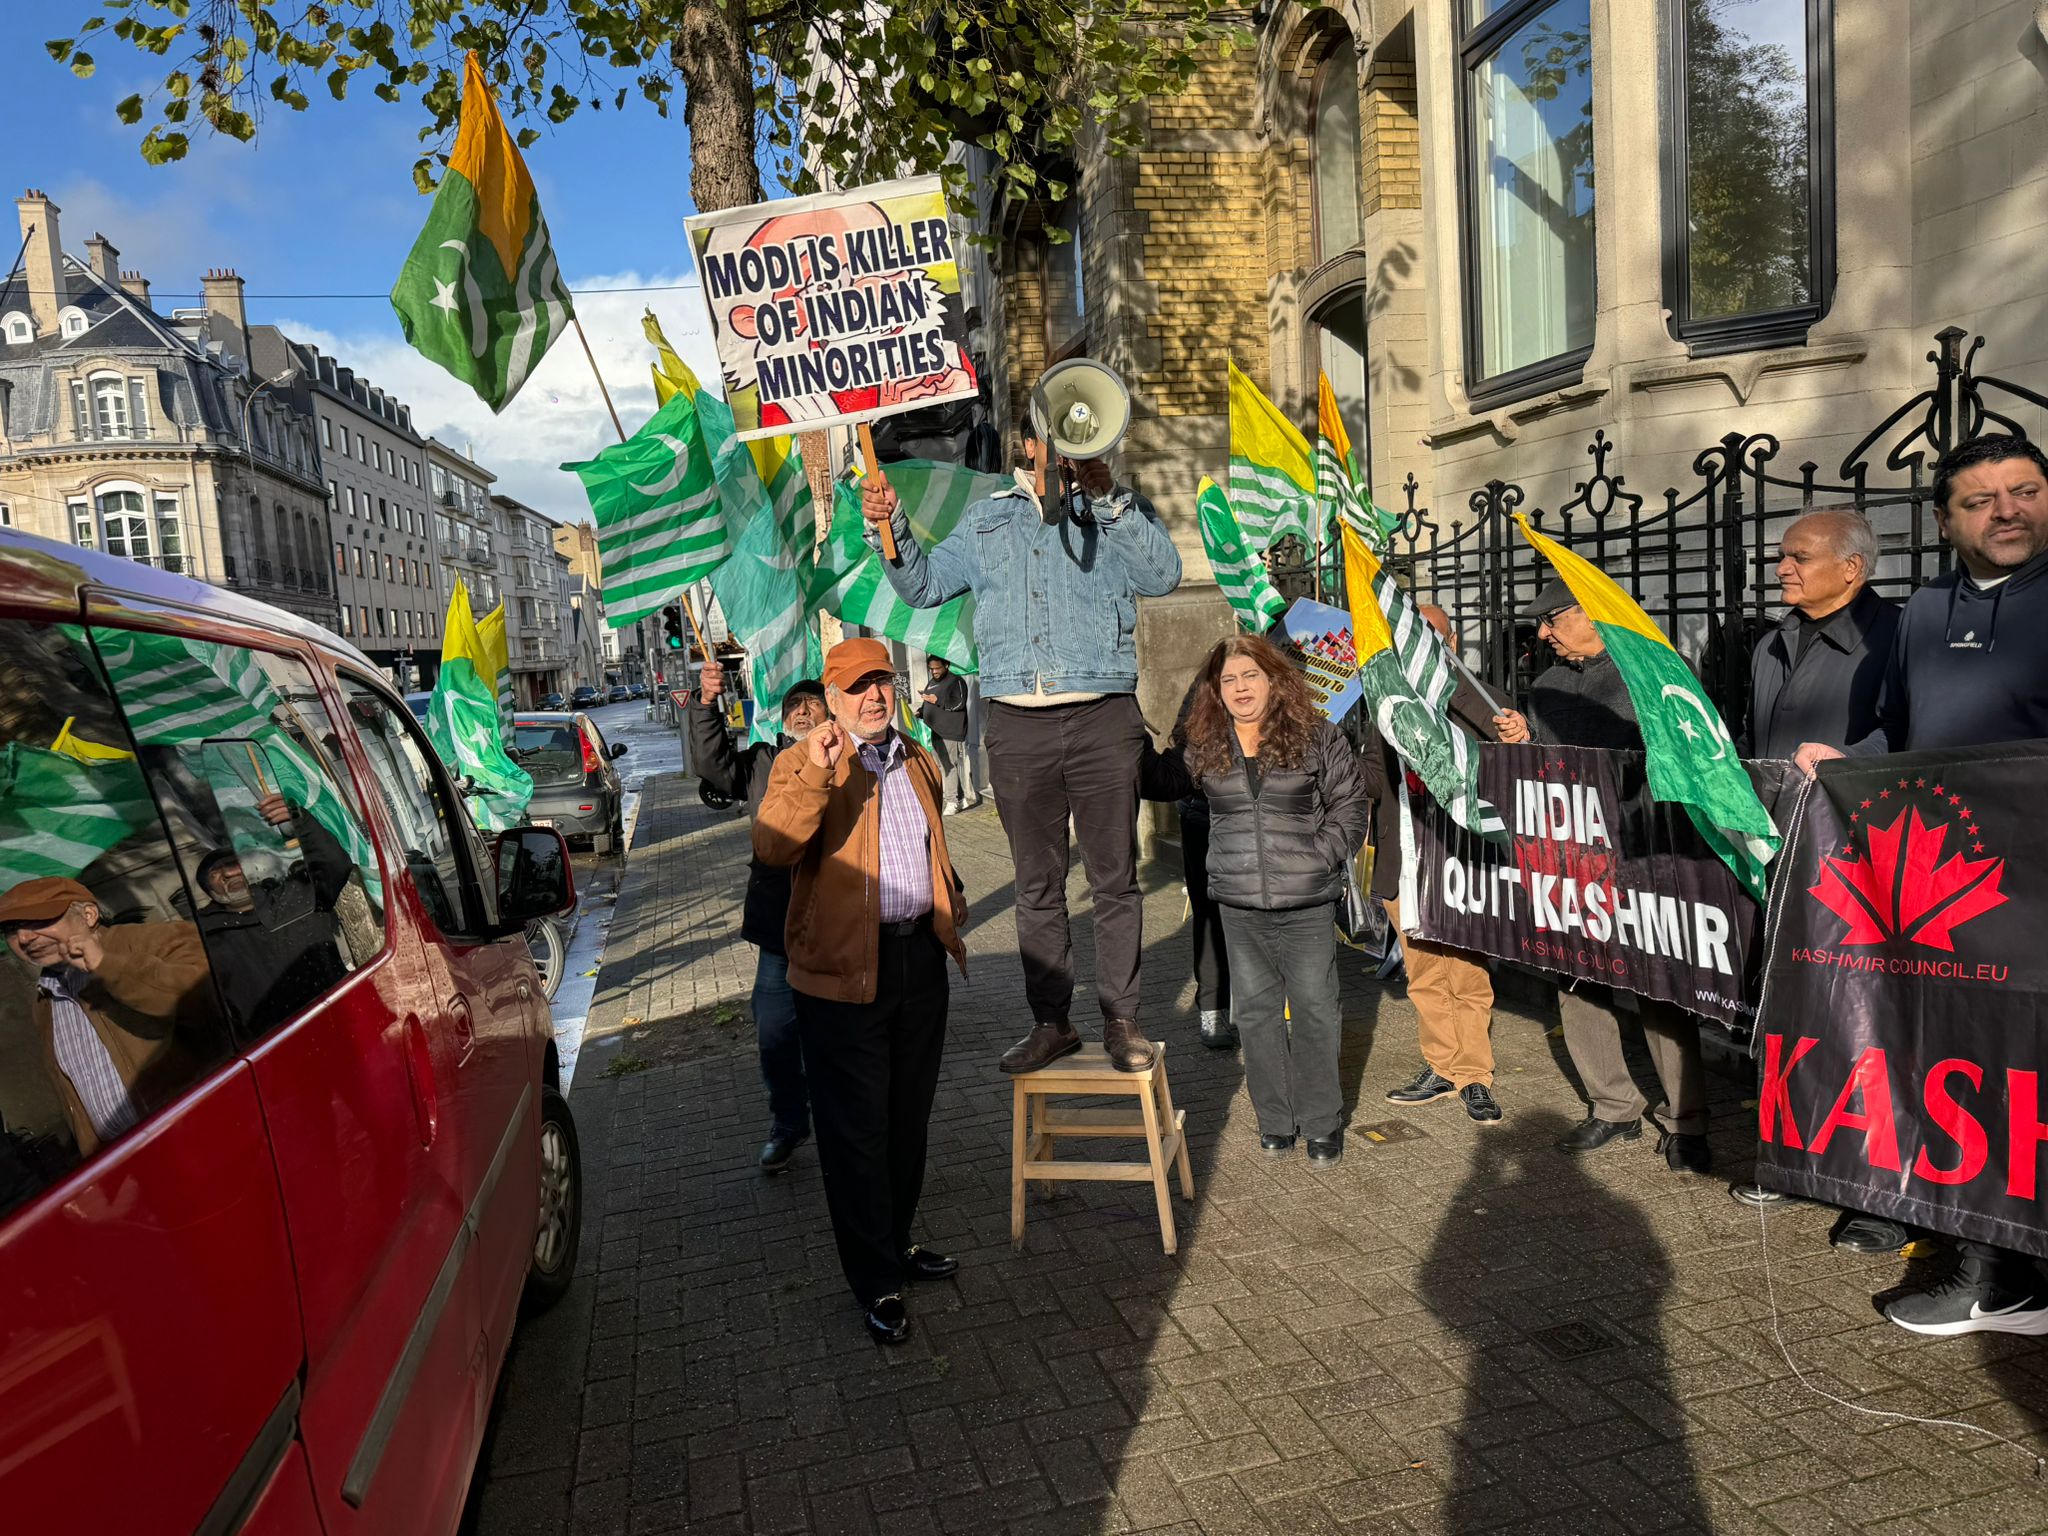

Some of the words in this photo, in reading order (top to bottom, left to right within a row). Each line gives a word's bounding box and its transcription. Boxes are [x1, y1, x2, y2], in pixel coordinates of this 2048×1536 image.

[705, 239, 803, 298] MODI
[807, 236, 841, 282] IS
[845, 219, 952, 275] KILLER
[756, 300, 798, 347] OF
[806, 280, 927, 338] INDIAN
[757, 329, 945, 402] MINORITIES
[1286, 647, 1355, 679] International
[1330, 680, 1345, 693] To
[1516, 778, 1612, 849] INDIA
[1443, 856, 1521, 921] QUIT
[1531, 872, 1733, 976] KASHMIR
[1791, 948, 1885, 973] KASHMIR
[1889, 958, 2008, 982] COUNCIL.EU
